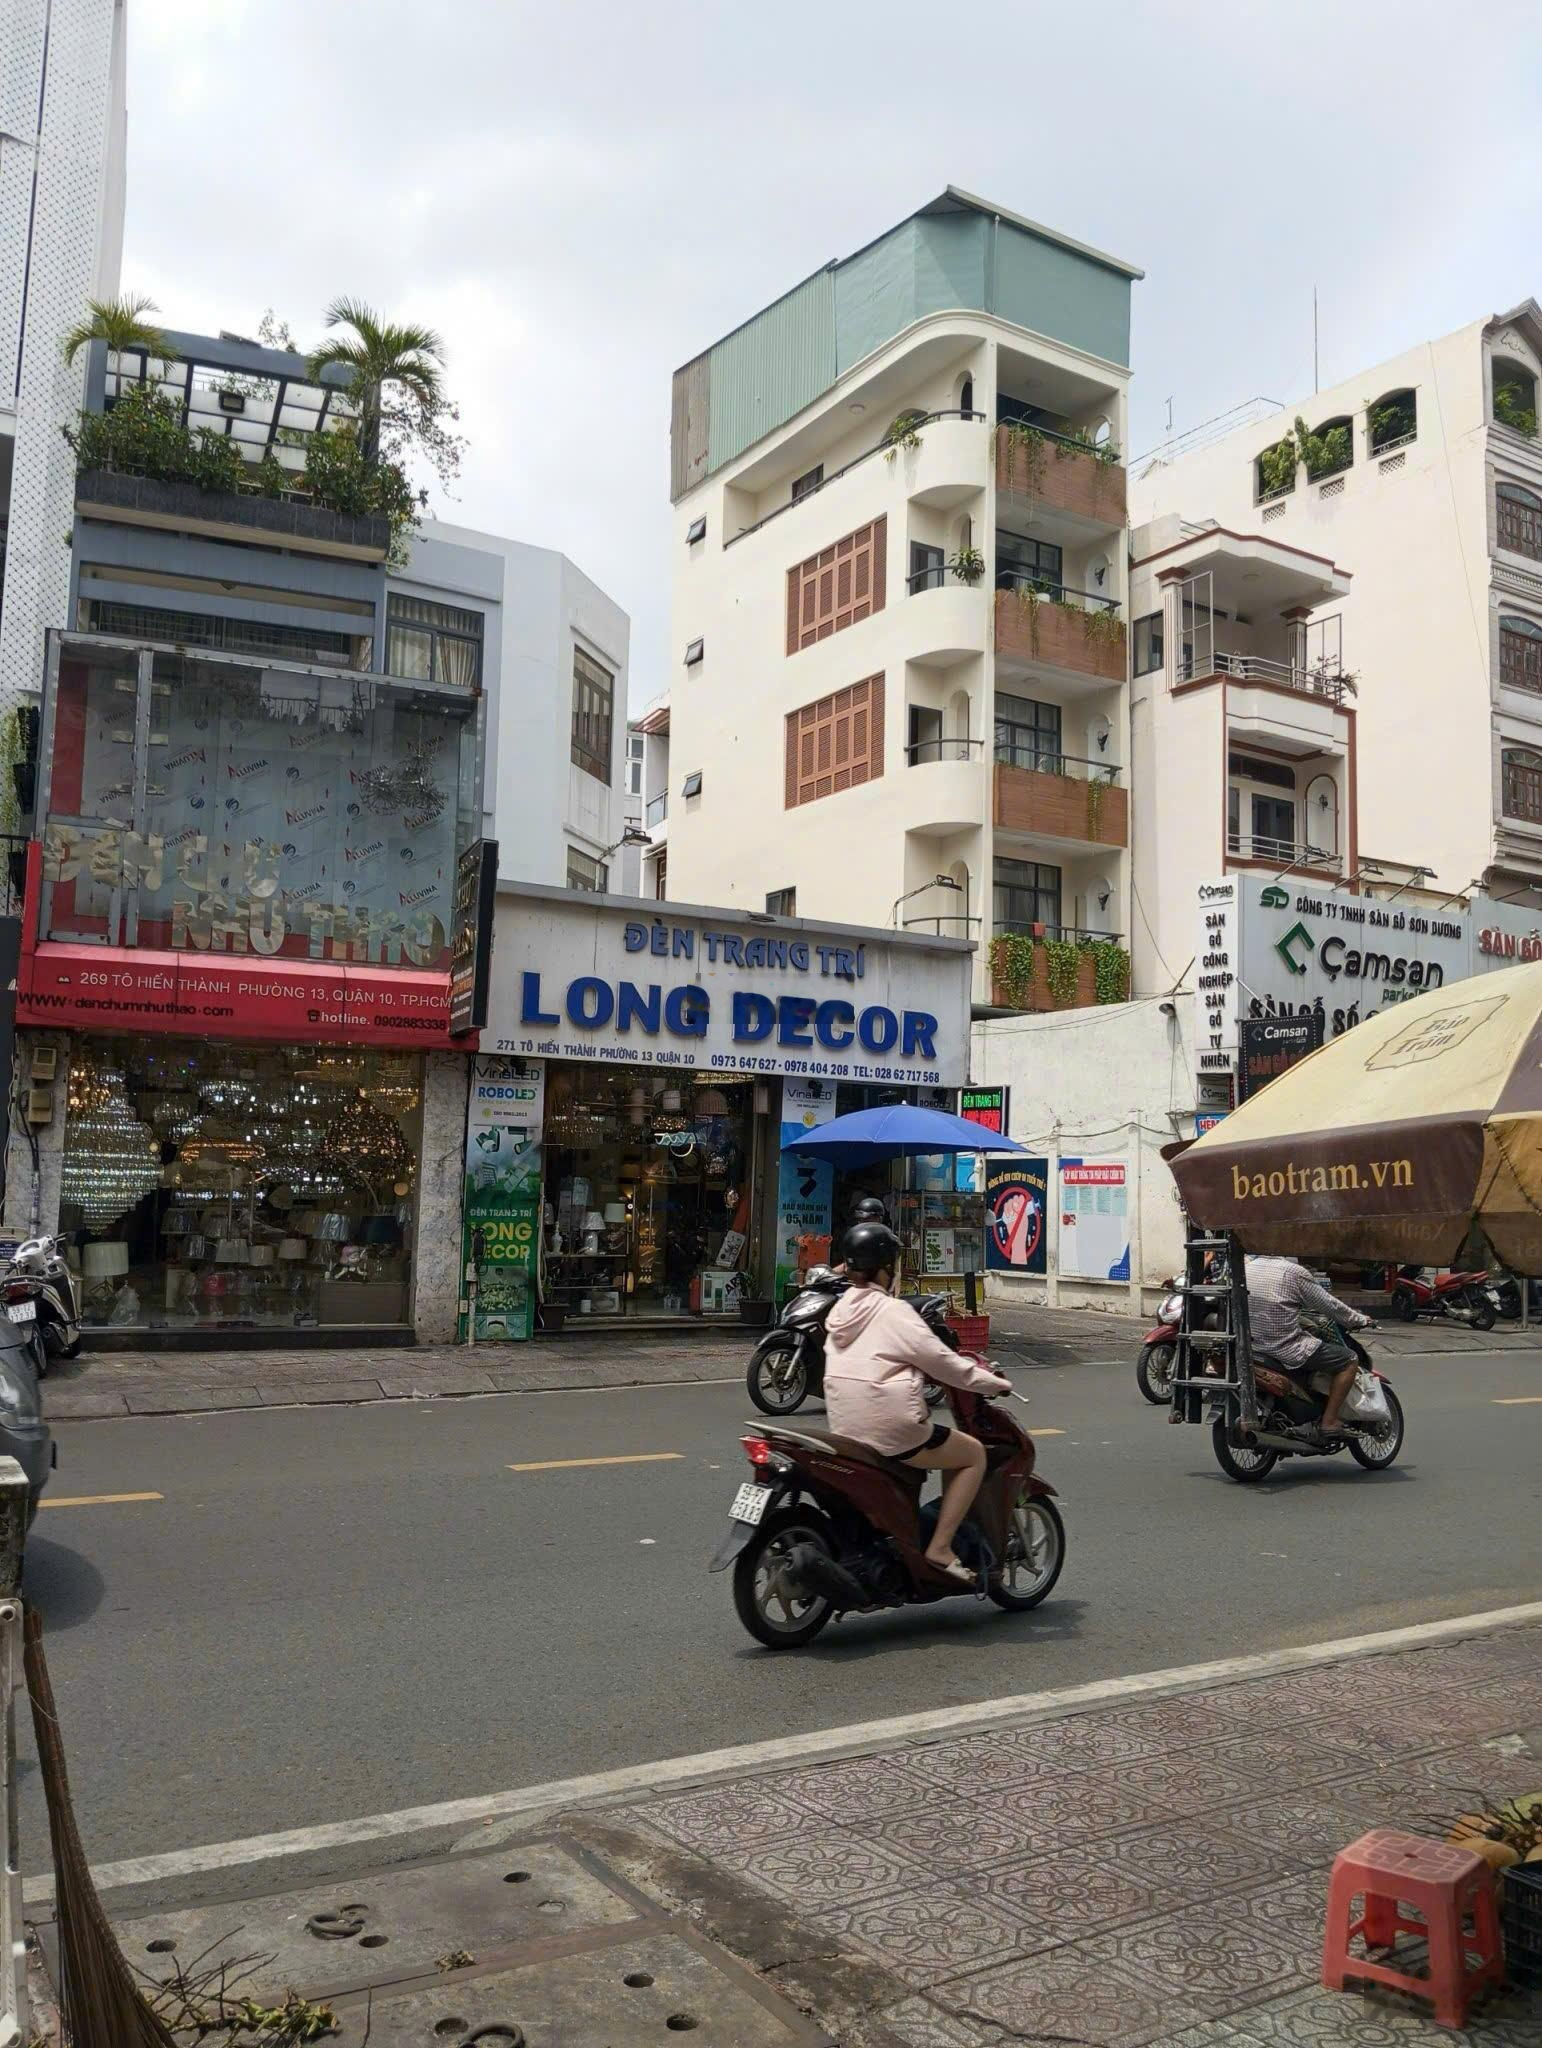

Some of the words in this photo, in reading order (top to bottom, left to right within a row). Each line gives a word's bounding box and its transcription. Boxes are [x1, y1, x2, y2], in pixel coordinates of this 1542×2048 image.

[1205, 912, 1225, 929] SÀN
[1296, 895, 1323, 917] CÔNG
[1325, 902, 1338, 919] TY
[1340, 905, 1365, 923] TNHH
[1369, 908, 1389, 928] SÀN
[1409, 917, 1429, 934] SƠN
[1431, 920, 1462, 940] DƯƠNG
[624, 918, 695, 960] ĐÈN
[703, 932, 808, 971] TRANG
[816, 942, 867, 982] TRÍ
[1478, 926, 1517, 960] SÀN
[1202, 952, 1228, 968] CÔNG
[79, 971, 108, 986] 269
[112, 972, 134, 988] TÔ
[137, 972, 174, 990] HIẾN
[178, 974, 231, 994] THÀNH
[238, 981, 305, 999] PHƯỜNG
[310, 988, 329, 1001] 13,
[332, 988, 375, 1006] QUẬN
[379, 993, 396, 1006] 10,
[1199, 971, 1234, 990] NGHIỆP
[1205, 992, 1225, 1009] SÀN
[520, 971, 711, 1040] LONG
[731, 989, 939, 1059] DECOR
[1209, 1033, 1222, 1048] TỰ
[496, 1039, 515, 1051] 271
[520, 1041, 533, 1052] TÔ
[537, 1039, 560, 1055] HIẾN
[564, 1043, 596, 1058] THÀNH
[599, 1046, 639, 1061] PHƯỜNG
[642, 1050, 653, 1062] 13
[656, 1051, 681, 1066] QUẬN
[684, 1053, 695, 1065] 10
[1200, 1052, 1230, 1069] NHIÊN
[710, 1054, 737, 1068] 0973
[739, 1056, 758, 1070] 647
[758, 1057, 777, 1071] 627
[784, 1059, 808, 1074] 0978
[809, 1061, 828, 1075] 404
[831, 1063, 849, 1077] 208
[853, 1065, 873, 1079] TEL:
[875, 1067, 892, 1080] 028
[893, 1068, 905, 1082] 62
[906, 1070, 922, 1083] 717
[923, 1071, 940, 1084] 568
[478, 1086, 536, 1101] ROBOLED
[1230, 1157, 1415, 1201] baotram.vn
[489, 1208, 519, 1218] TRANG
